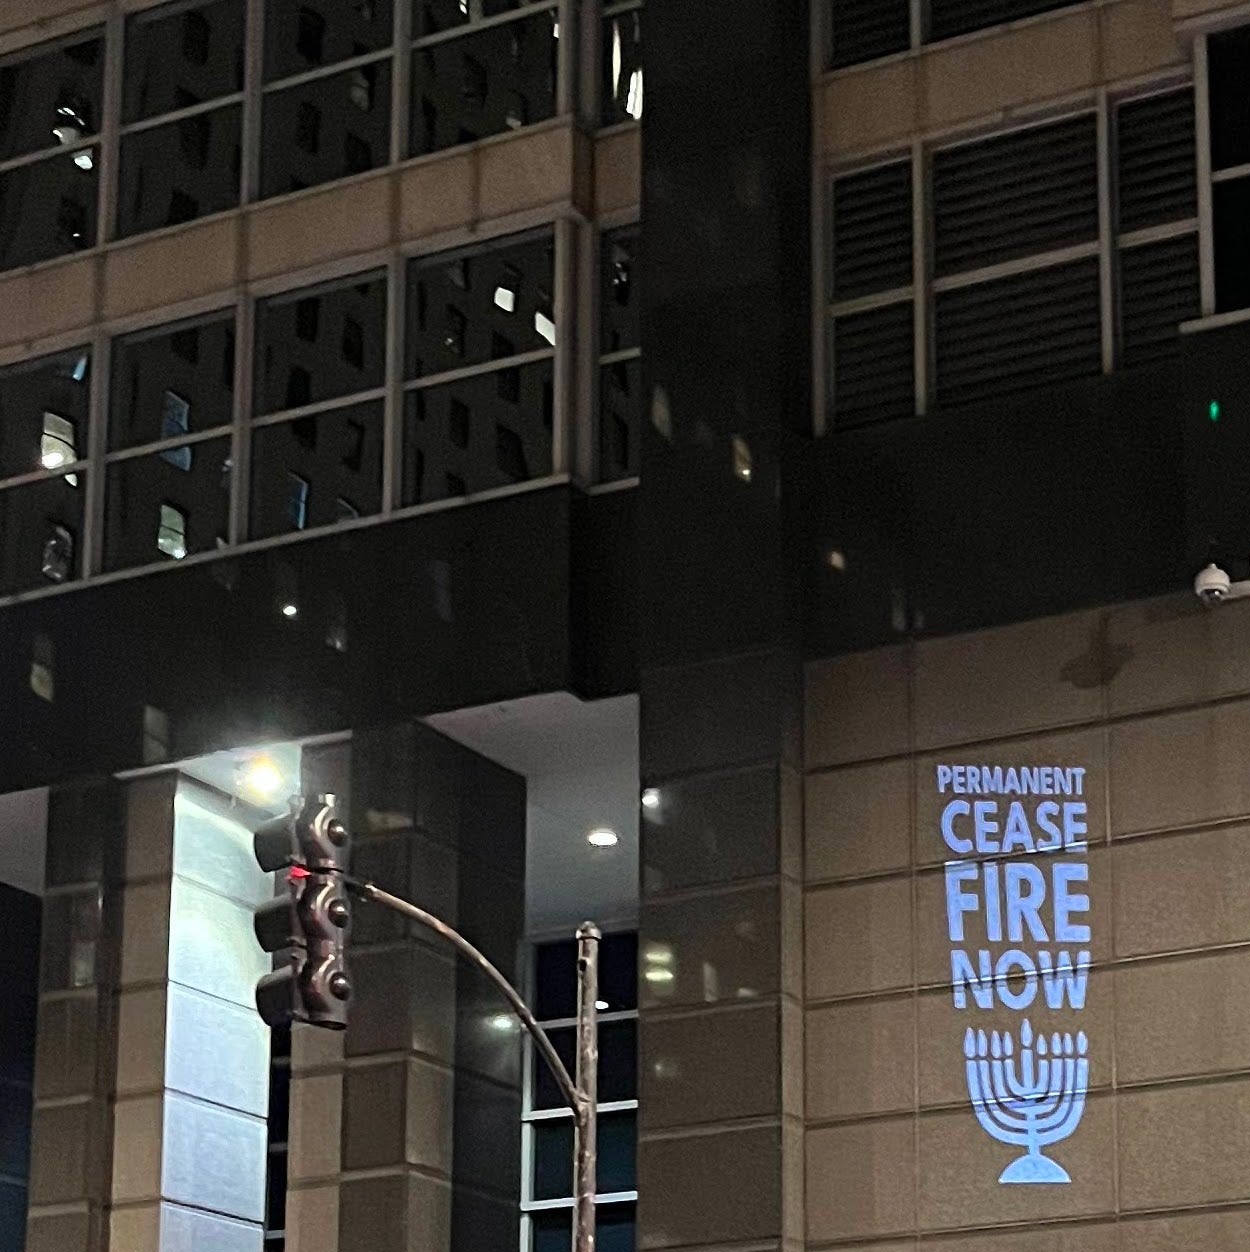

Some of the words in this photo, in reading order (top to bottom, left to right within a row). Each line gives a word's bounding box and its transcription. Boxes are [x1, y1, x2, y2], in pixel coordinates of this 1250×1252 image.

[937, 765, 1086, 795] PERMANENT
[940, 800, 1088, 854] CEASE
[945, 861, 1091, 943] FIRE
[951, 949, 1091, 1010] NOW
